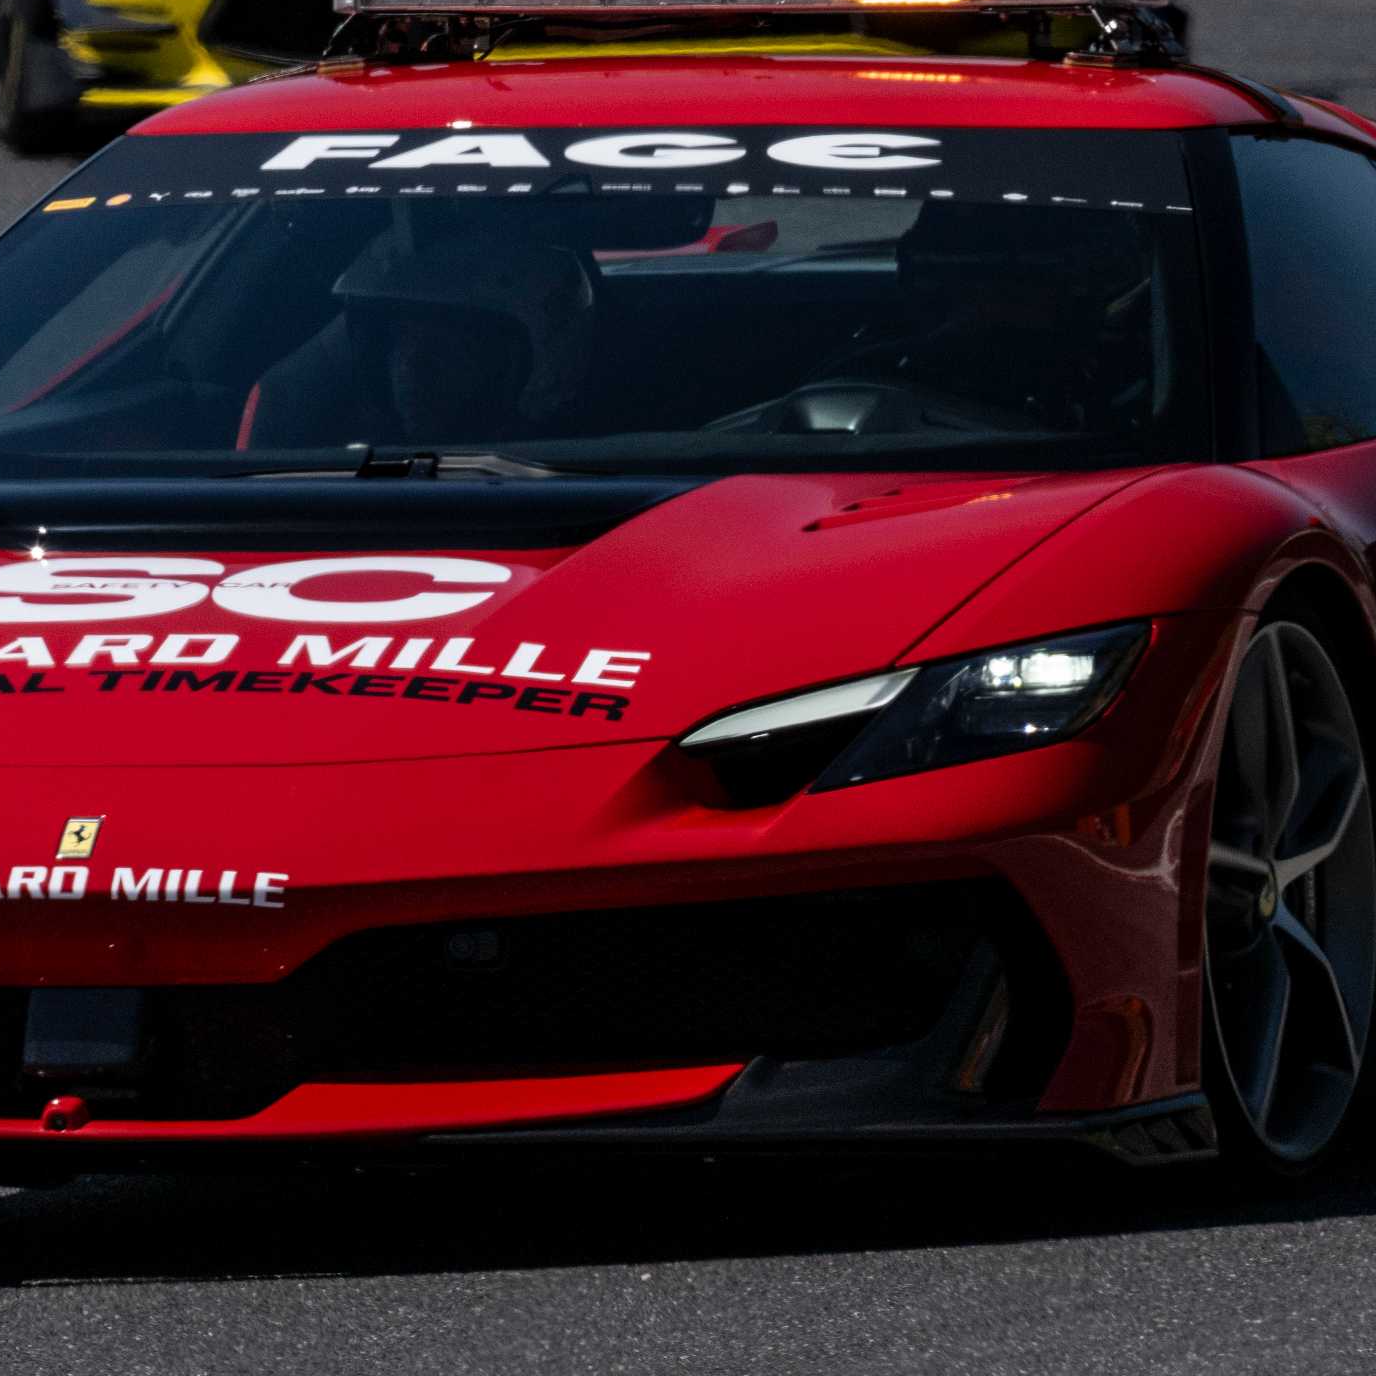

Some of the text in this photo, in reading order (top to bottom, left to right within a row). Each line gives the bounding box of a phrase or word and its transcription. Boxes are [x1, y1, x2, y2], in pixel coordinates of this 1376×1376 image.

[261, 132, 942, 171] FAGE
[50, 581, 295, 590] SAFETY CAR
[277, 634, 652, 688] MILLE
[88, 670, 631, 722] TIMEKEEPER
[111, 866, 290, 910] MILLE
